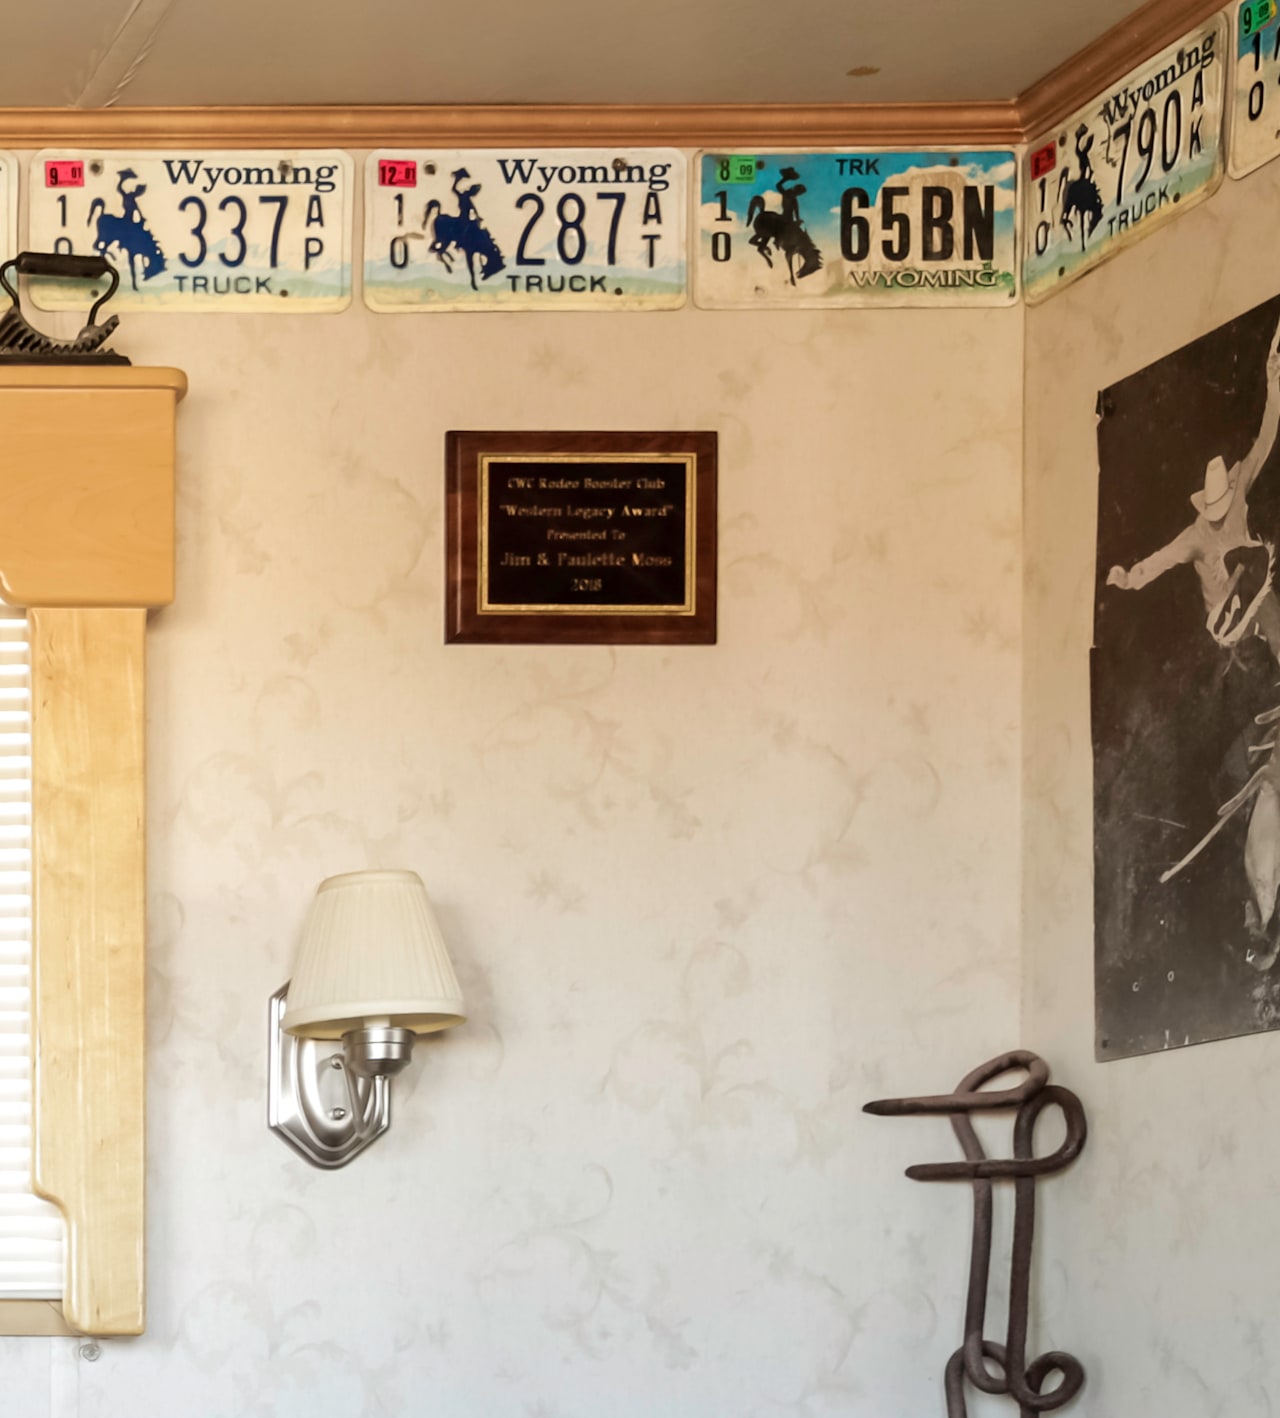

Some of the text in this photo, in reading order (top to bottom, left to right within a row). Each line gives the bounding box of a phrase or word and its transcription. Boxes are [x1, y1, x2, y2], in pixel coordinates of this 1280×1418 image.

[1100, 31, 1217, 126] Wyoming
[1113, 89, 1182, 207] 790
[49, 167, 59, 186] 9
[163, 160, 339, 193] Wyoming
[497, 159, 672, 192] Wyoming
[719, 158, 731, 182] 8
[835, 158, 880, 176] TRK
[1107, 182, 1170, 237] TRUCK
[178, 195, 289, 269] 337
[515, 192, 627, 266] 287
[840, 185, 995, 263] 65BN
[174, 276, 272, 294] TRUCK
[506, 275, 607, 293] TRUCK
[851, 268, 1000, 288] WYOMING
[538, 477, 580, 490] Rodeo
[636, 477, 665, 490] Club
[566, 504, 616, 520] Legacy
[546, 528, 608, 541] Presented
[499, 552, 532, 567] Jim
[536, 552, 550, 567] &
[556, 552, 626, 567] Paulette
